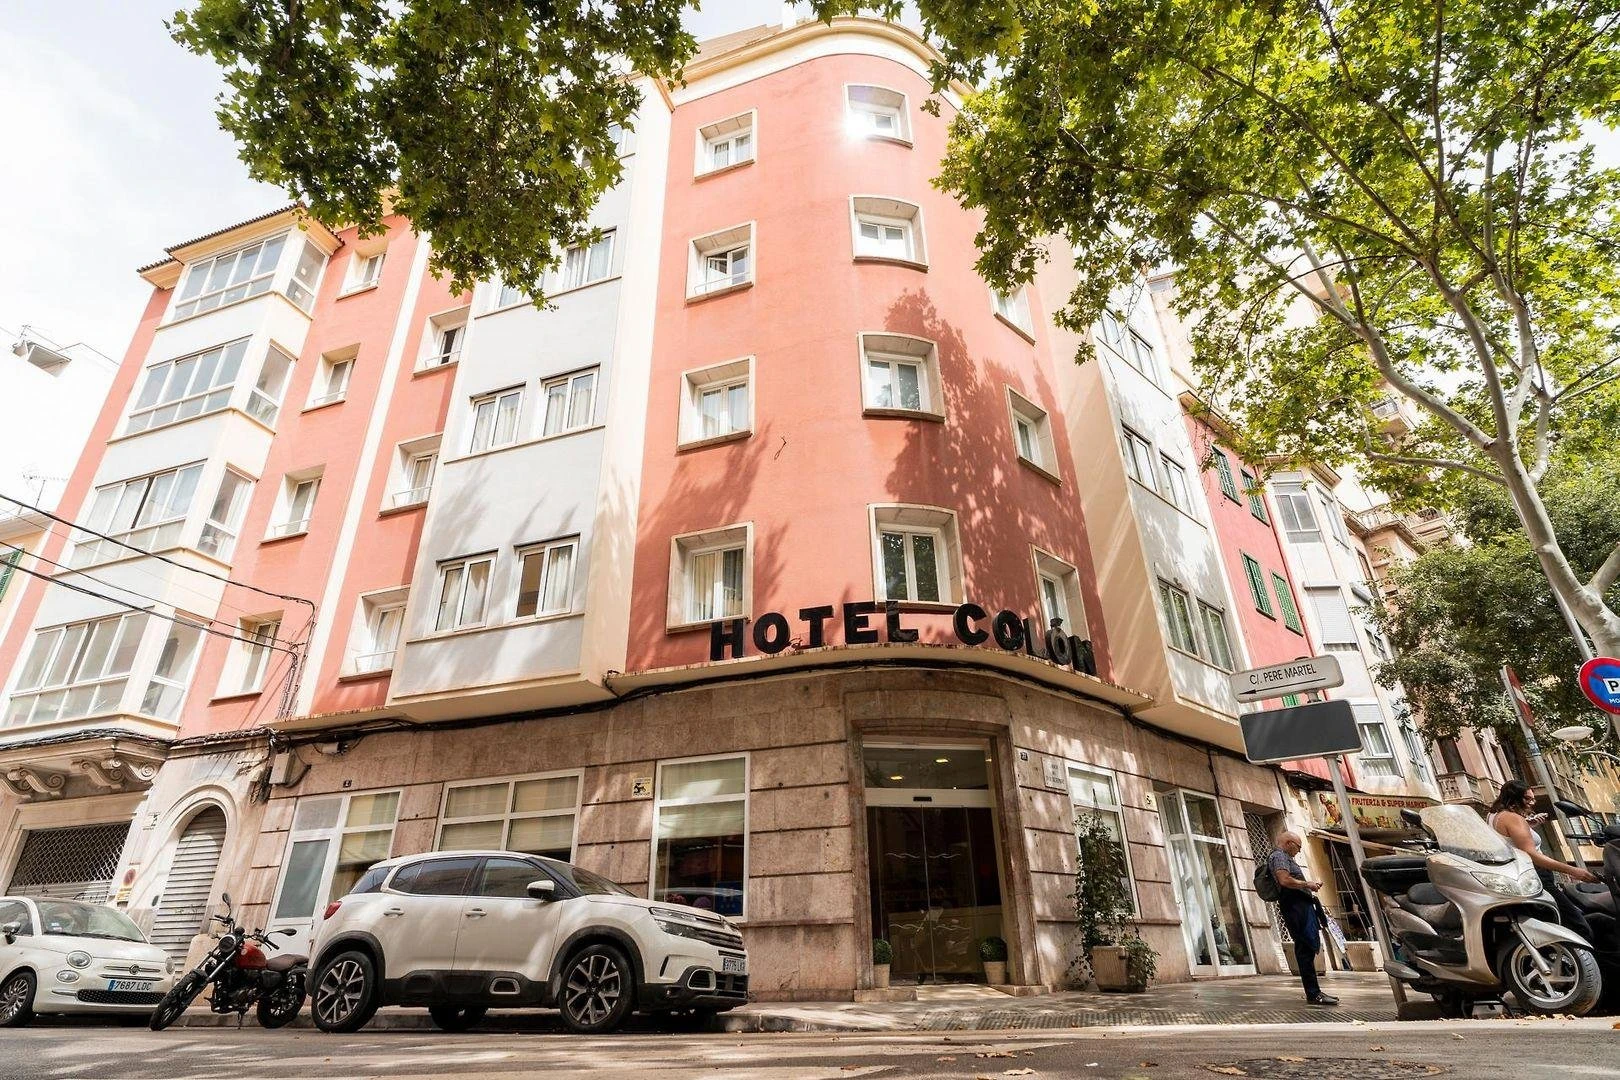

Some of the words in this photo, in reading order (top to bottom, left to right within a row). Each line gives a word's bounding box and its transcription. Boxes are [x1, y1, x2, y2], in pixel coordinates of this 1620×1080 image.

[710, 600, 919, 661] HOTEL
[1264, 669, 1283, 682] PERE
[1284, 664, 1317, 679] MARTEL
[1608, 680, 1619, 692] P
[1387, 799, 1405, 809] SUPER
[114, 980, 136, 990] 7687
